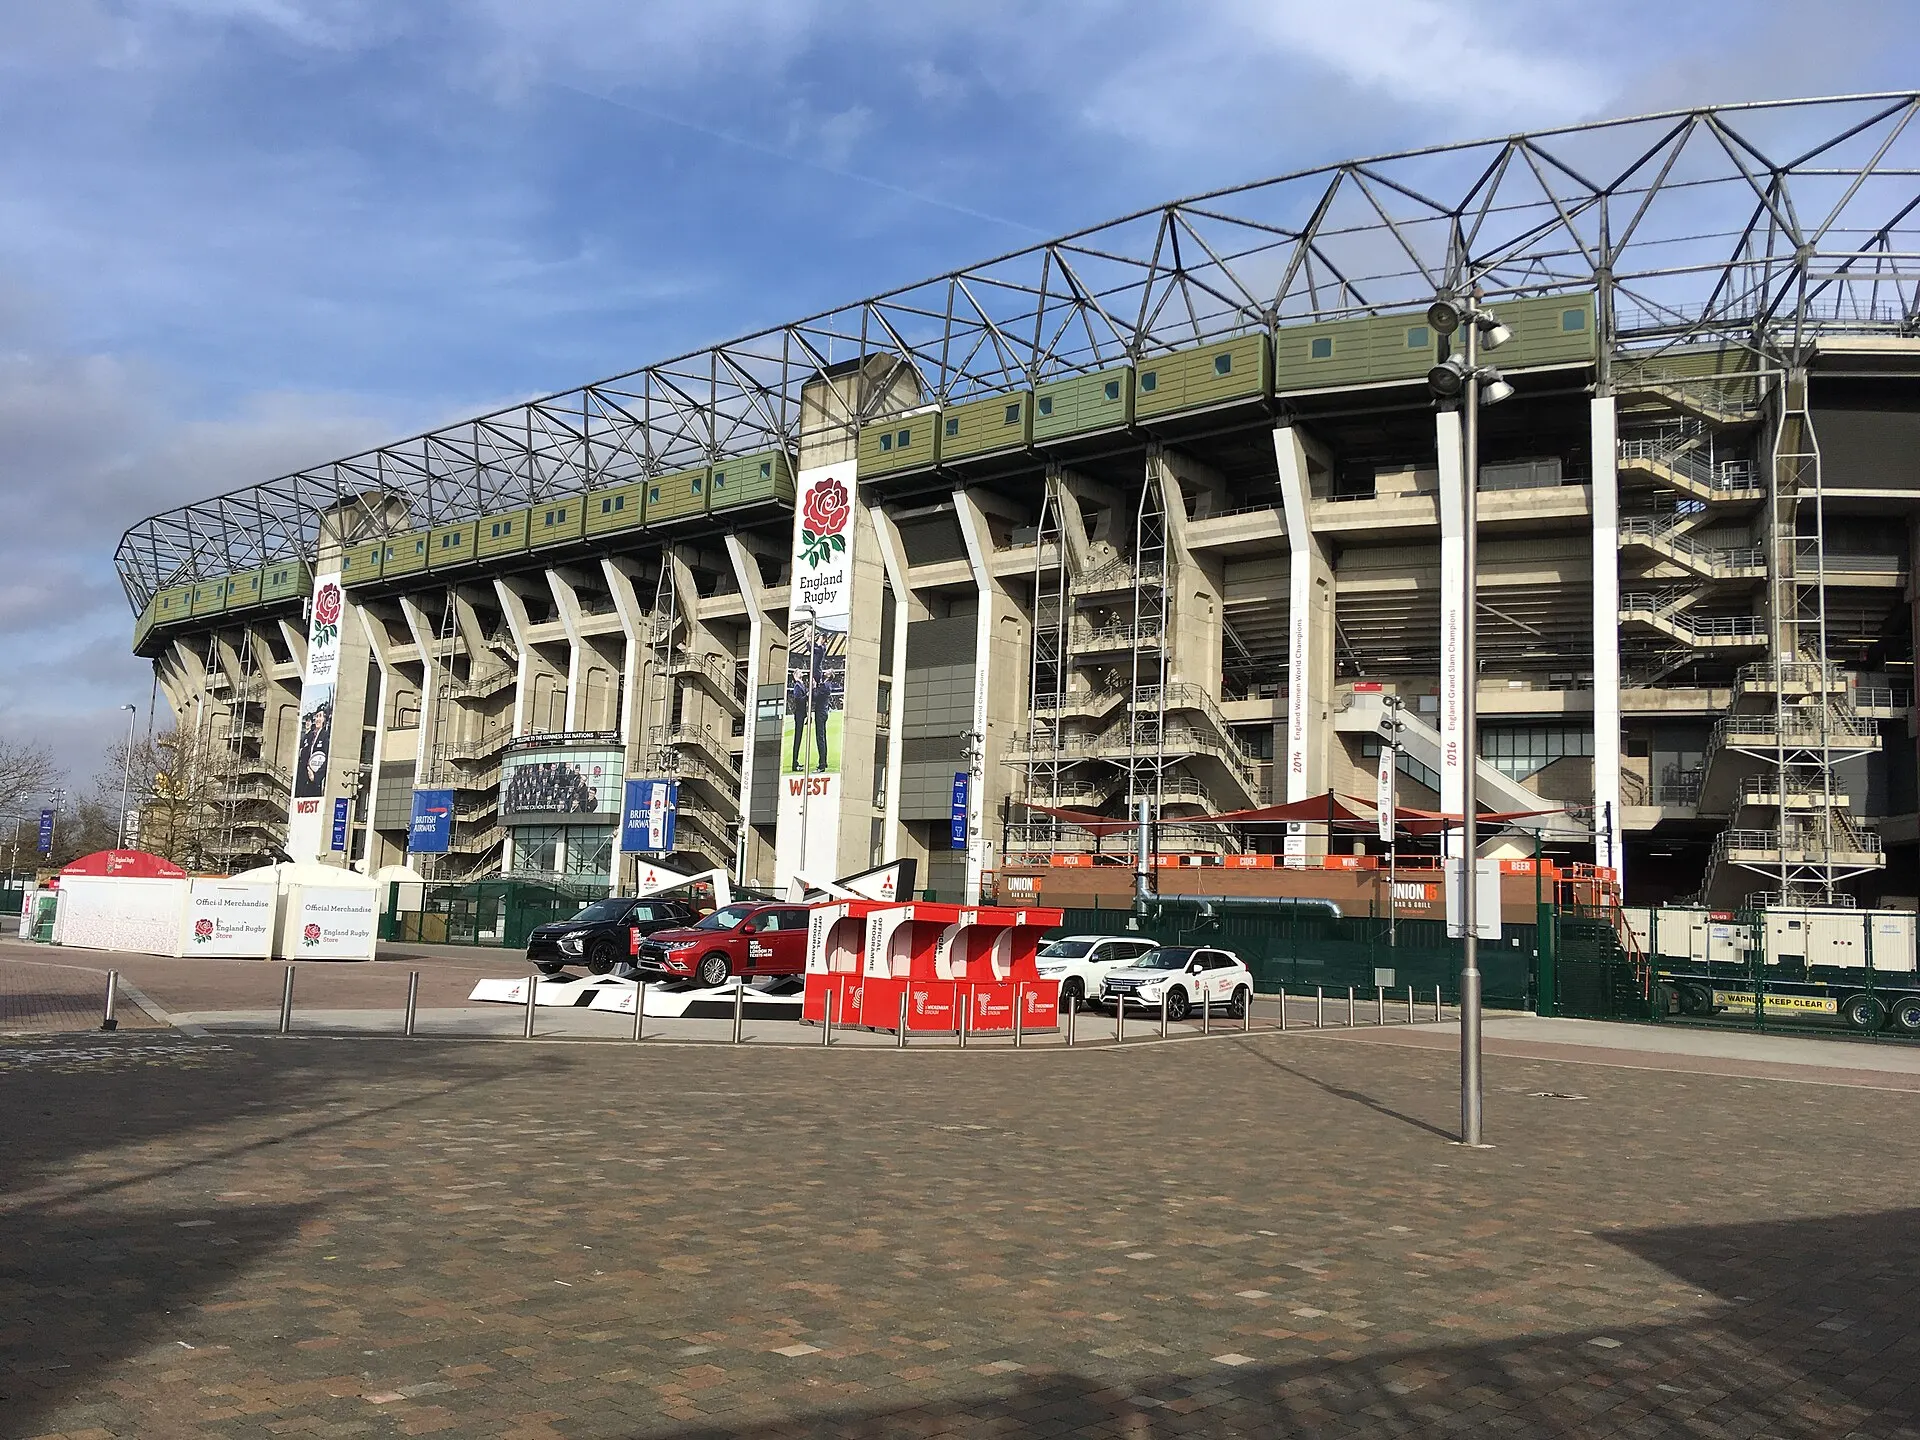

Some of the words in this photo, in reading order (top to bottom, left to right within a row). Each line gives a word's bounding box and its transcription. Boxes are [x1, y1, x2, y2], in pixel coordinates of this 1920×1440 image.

[800, 570, 842, 590] England
[803, 588, 837, 604] Rugby
[1448, 609, 1458, 652] Champions
[1296, 618, 1304, 658] Champions
[311, 650, 335, 664] England
[313, 663, 332, 676] Rugby
[1448, 702, 1458, 731] England
[1447, 741, 1457, 767] 2016
[1294, 751, 1302, 773] 2014
[789, 777, 830, 796] WEST
[297, 800, 319, 814] WEST
[630, 810, 650, 818] BRITIS
[416, 816, 436, 824] BRITISH
[628, 820, 650, 828] AIRWA
[414, 824, 436, 832] AIRWAYS
[1063, 856, 1079, 864] PIZZA
[1240, 856, 1256, 866] CIDER
[1342, 857, 1359, 867] WINE
[1511, 862, 1530, 871] BEER
[1008, 877, 1042, 891] UNION15
